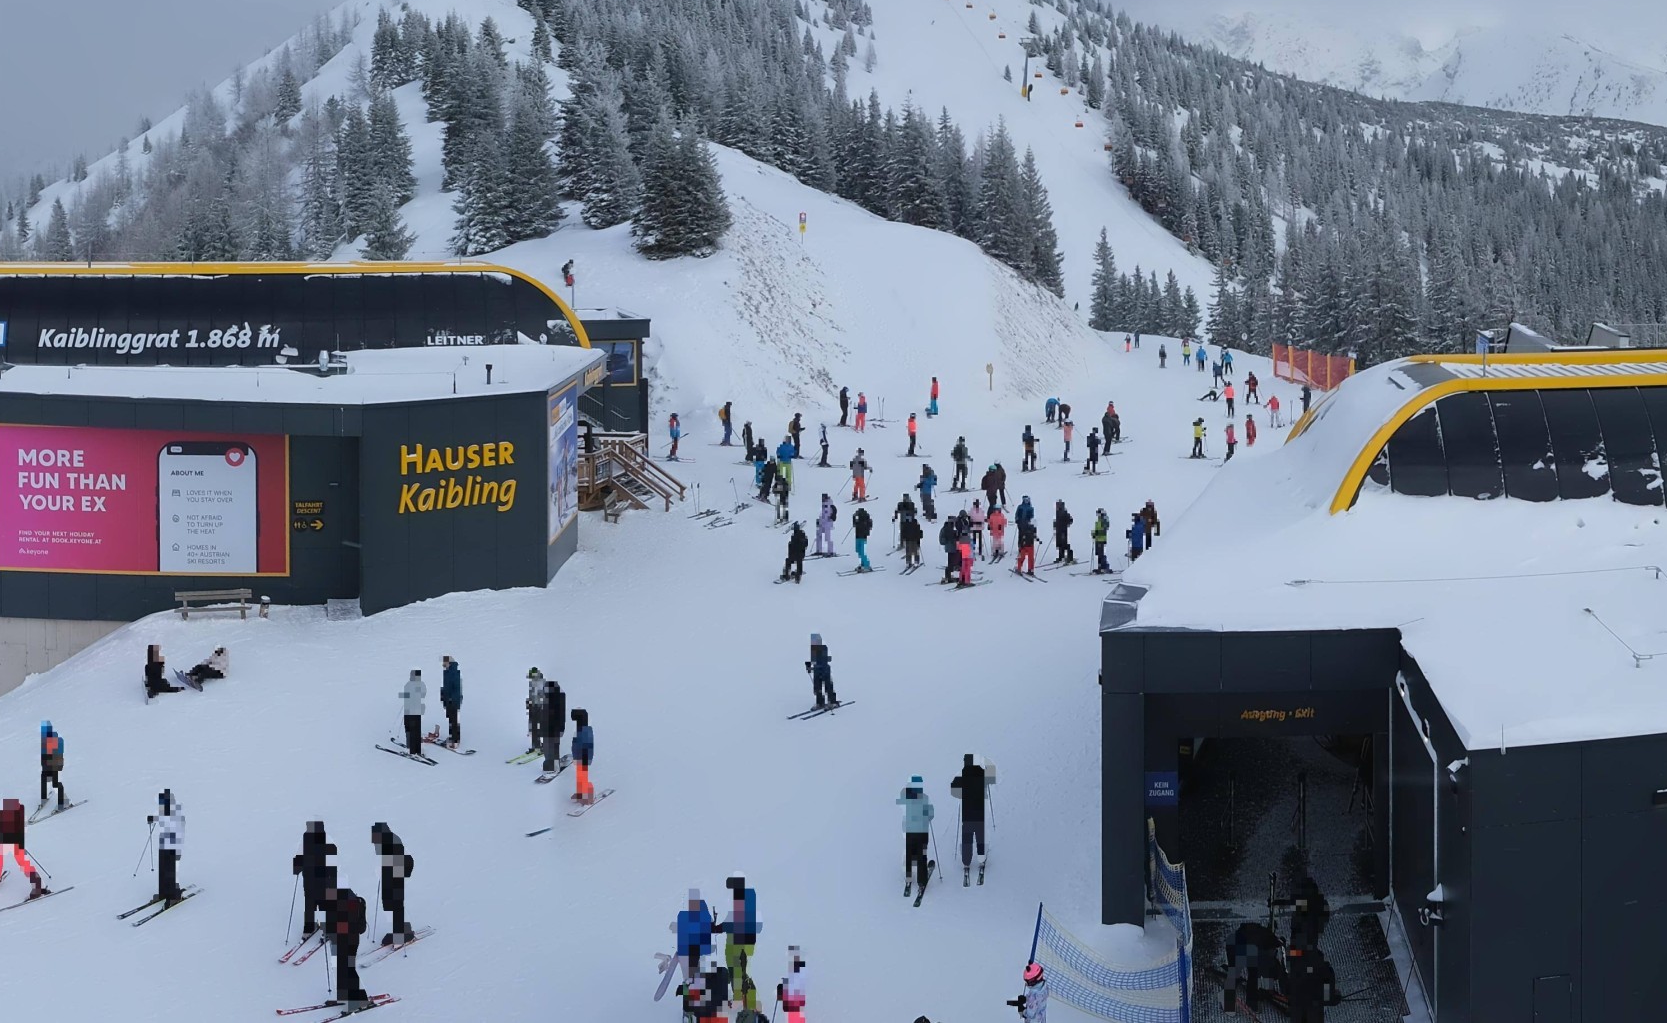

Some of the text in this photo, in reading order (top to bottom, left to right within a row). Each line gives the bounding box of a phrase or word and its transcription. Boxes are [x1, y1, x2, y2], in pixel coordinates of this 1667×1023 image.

[38, 327, 280, 355] Kaiblinggrat 1.868 m
[427, 335, 484, 345] LEITNER
[18, 449, 84, 467] MORE
[400, 441, 514, 475] HAUSER
[18, 472, 126, 490] FUN THAN
[18, 495, 106, 511] YOUR EX
[398, 475, 517, 514] Kaibling
